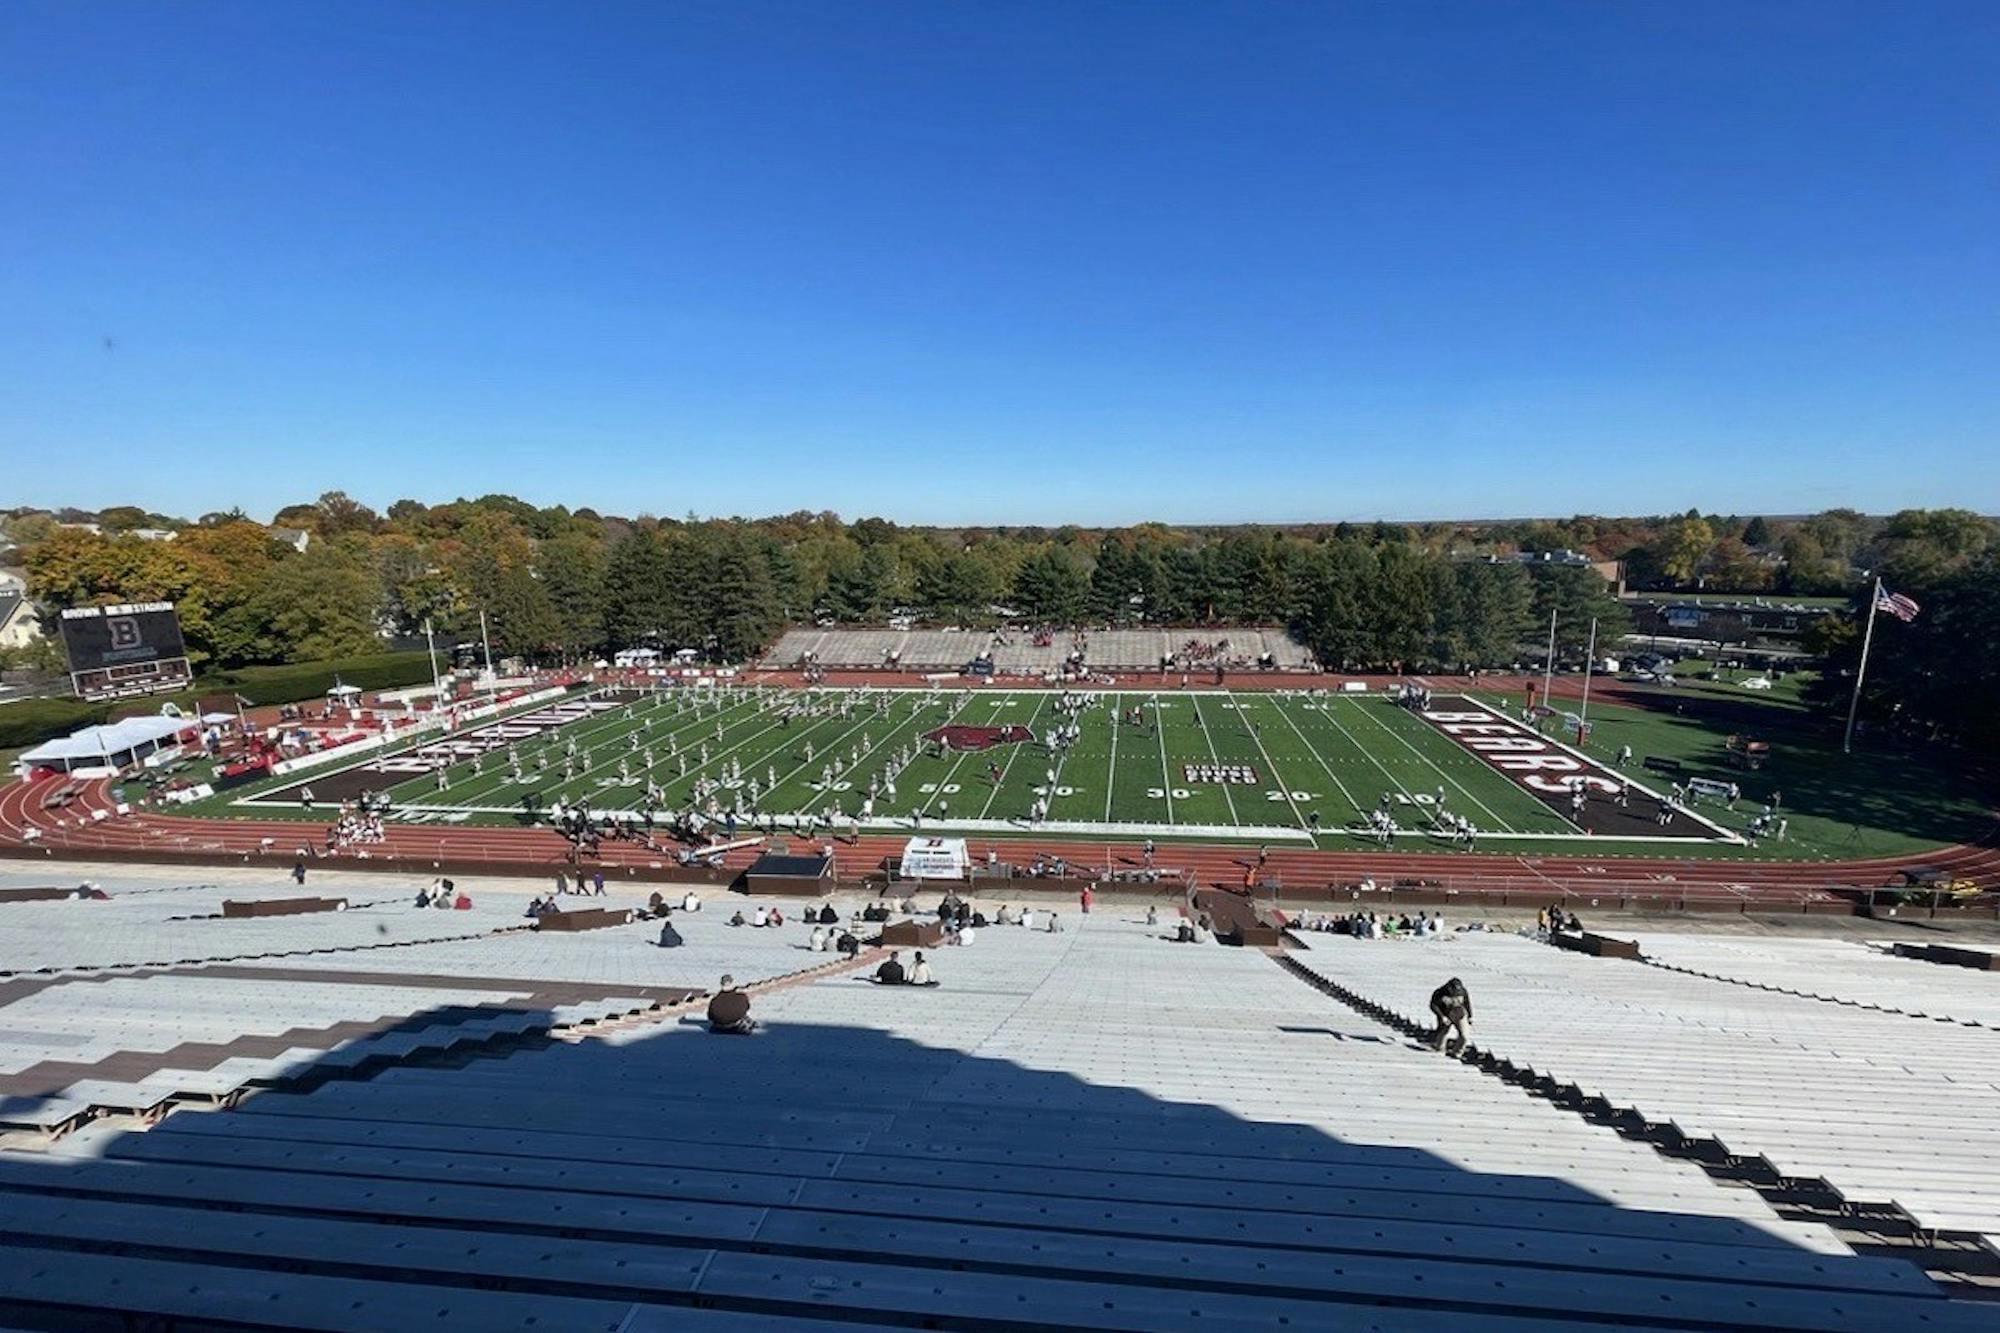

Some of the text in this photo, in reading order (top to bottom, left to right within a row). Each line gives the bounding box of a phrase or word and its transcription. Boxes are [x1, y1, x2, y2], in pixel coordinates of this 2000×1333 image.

[107, 616, 143, 650] B
[1421, 711, 1620, 794] BEARS
[919, 783, 962, 794] 50
[1147, 787, 1190, 799] 30
[1266, 790, 1312, 802] 20
[1394, 793, 1436, 805] 10
